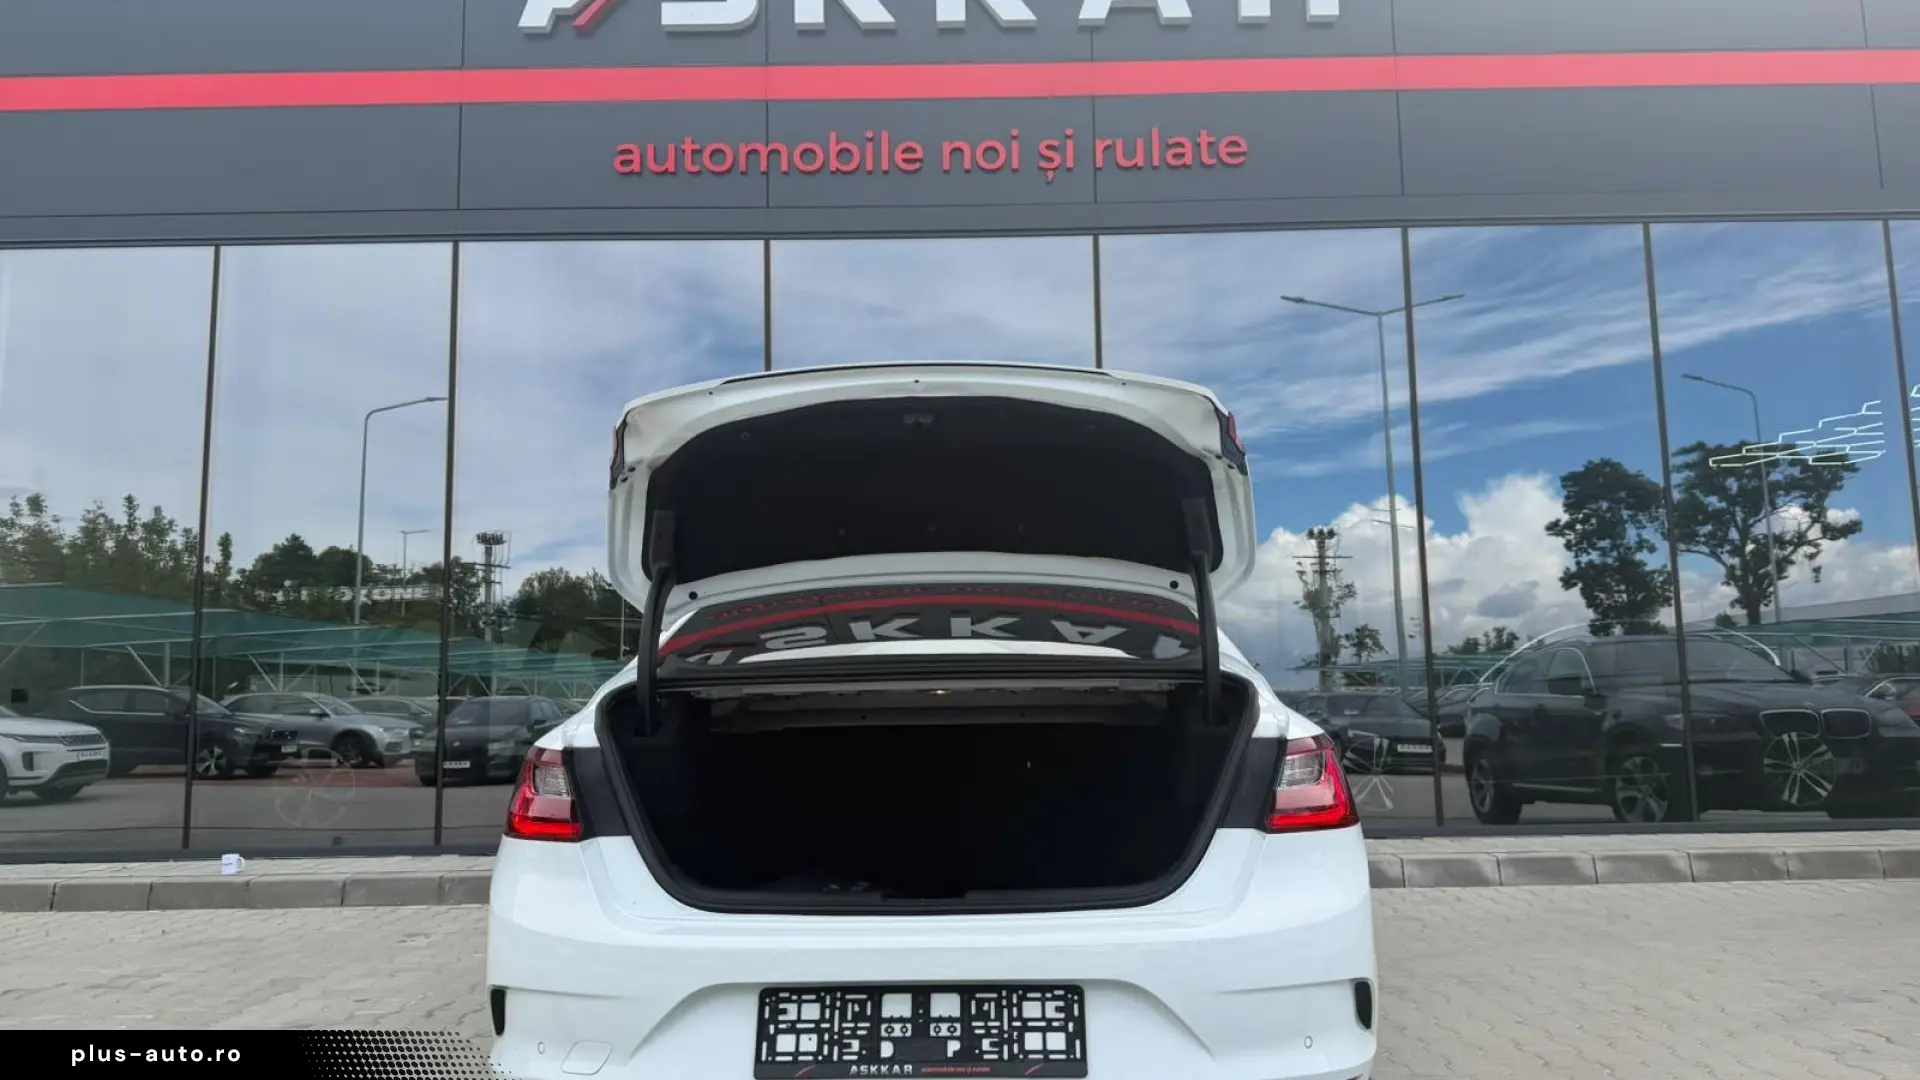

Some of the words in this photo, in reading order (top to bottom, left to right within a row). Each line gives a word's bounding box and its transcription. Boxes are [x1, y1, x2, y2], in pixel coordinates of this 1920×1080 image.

[613, 130, 925, 174] automobile
[941, 128, 1019, 173] noi
[1037, 128, 1075, 184] și
[1095, 127, 1248, 171] rulate
[849, 1063, 913, 1076] ASKKAR
